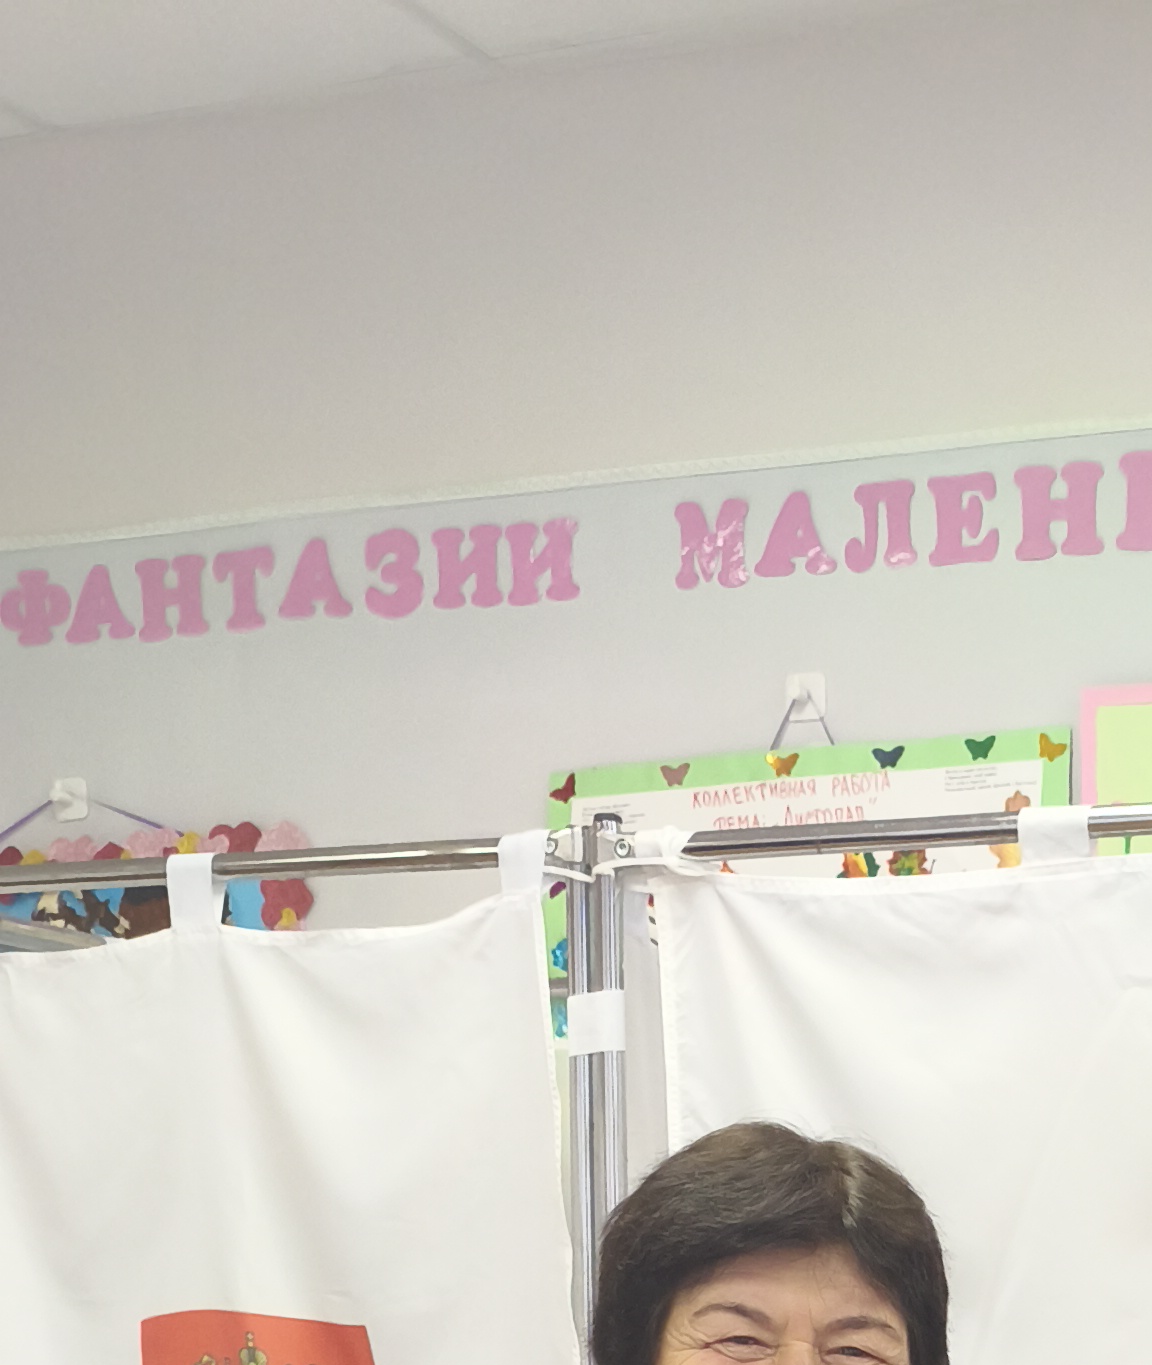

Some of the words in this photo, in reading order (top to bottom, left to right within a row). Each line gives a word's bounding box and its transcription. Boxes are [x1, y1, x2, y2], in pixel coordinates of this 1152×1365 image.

[0, 518, 580, 646] ФАНТАЗИИ
[693, 778, 817, 809] КОЛЛЕКТИВНАЯ
[832, 770, 891, 798] РАБОТА
